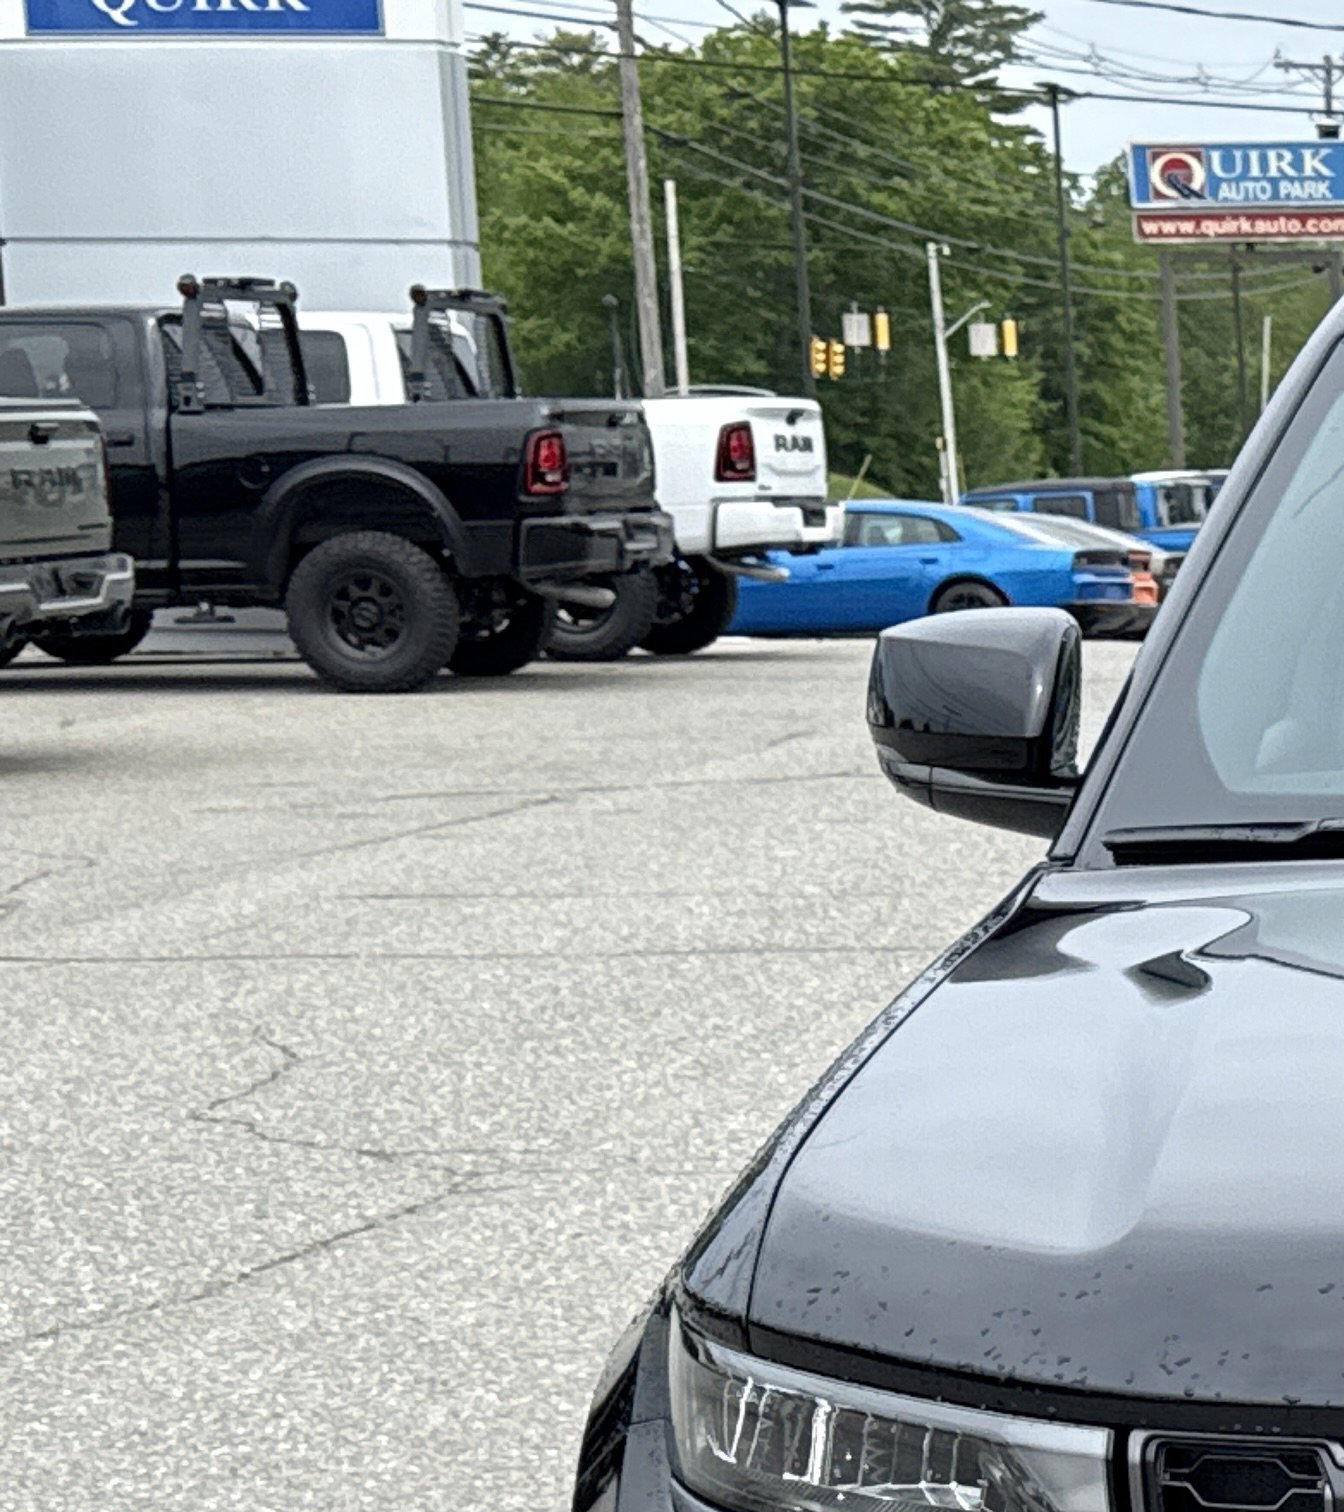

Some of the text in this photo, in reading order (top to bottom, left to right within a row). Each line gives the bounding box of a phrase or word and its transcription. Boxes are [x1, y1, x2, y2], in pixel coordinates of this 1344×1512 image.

[1150, 149, 1335, 200] QUIRK
[1218, 180, 1333, 199] AUTO PARK
